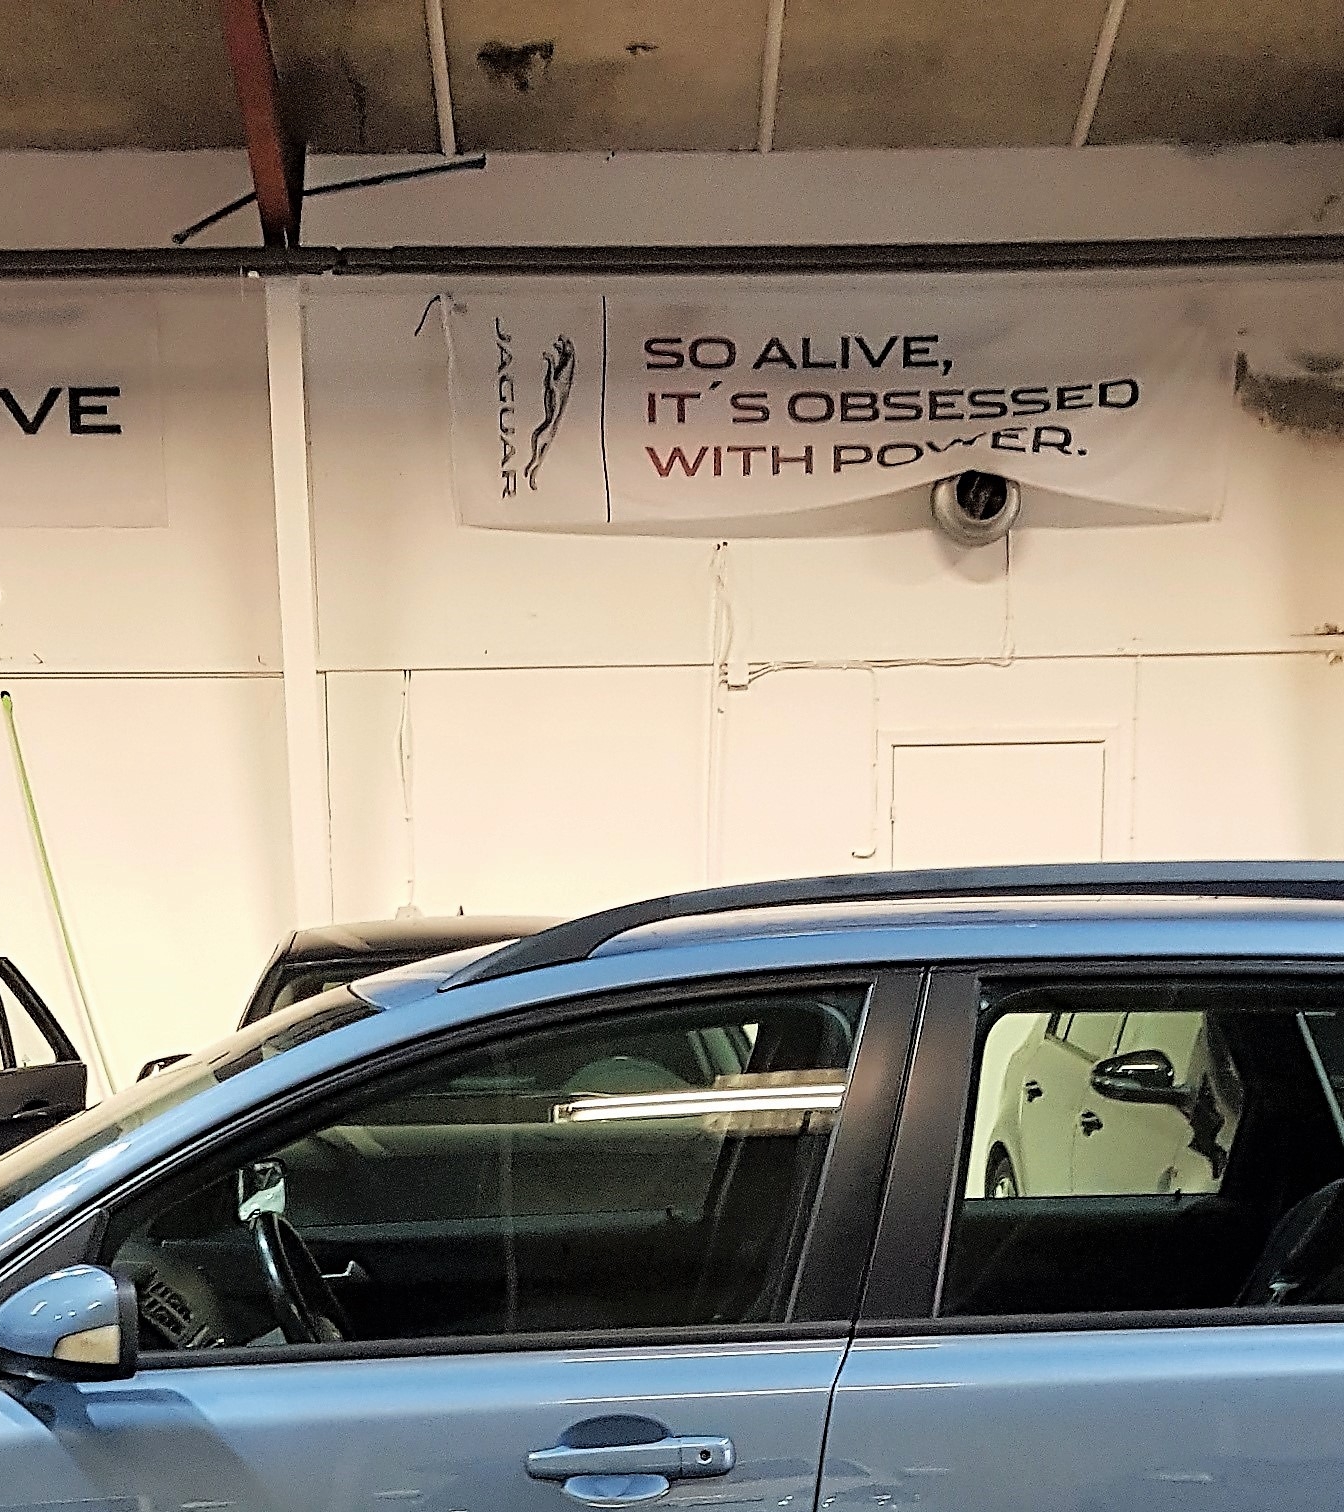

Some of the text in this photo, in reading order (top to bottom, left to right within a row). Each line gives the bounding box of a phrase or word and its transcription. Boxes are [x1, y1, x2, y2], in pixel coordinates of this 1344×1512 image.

[643, 334, 953, 377] SO ALIVE,
[495, 316, 518, 500] JAGUAR
[787, 378, 1140, 424] OBSESSED
[644, 445, 814, 478] WITH
